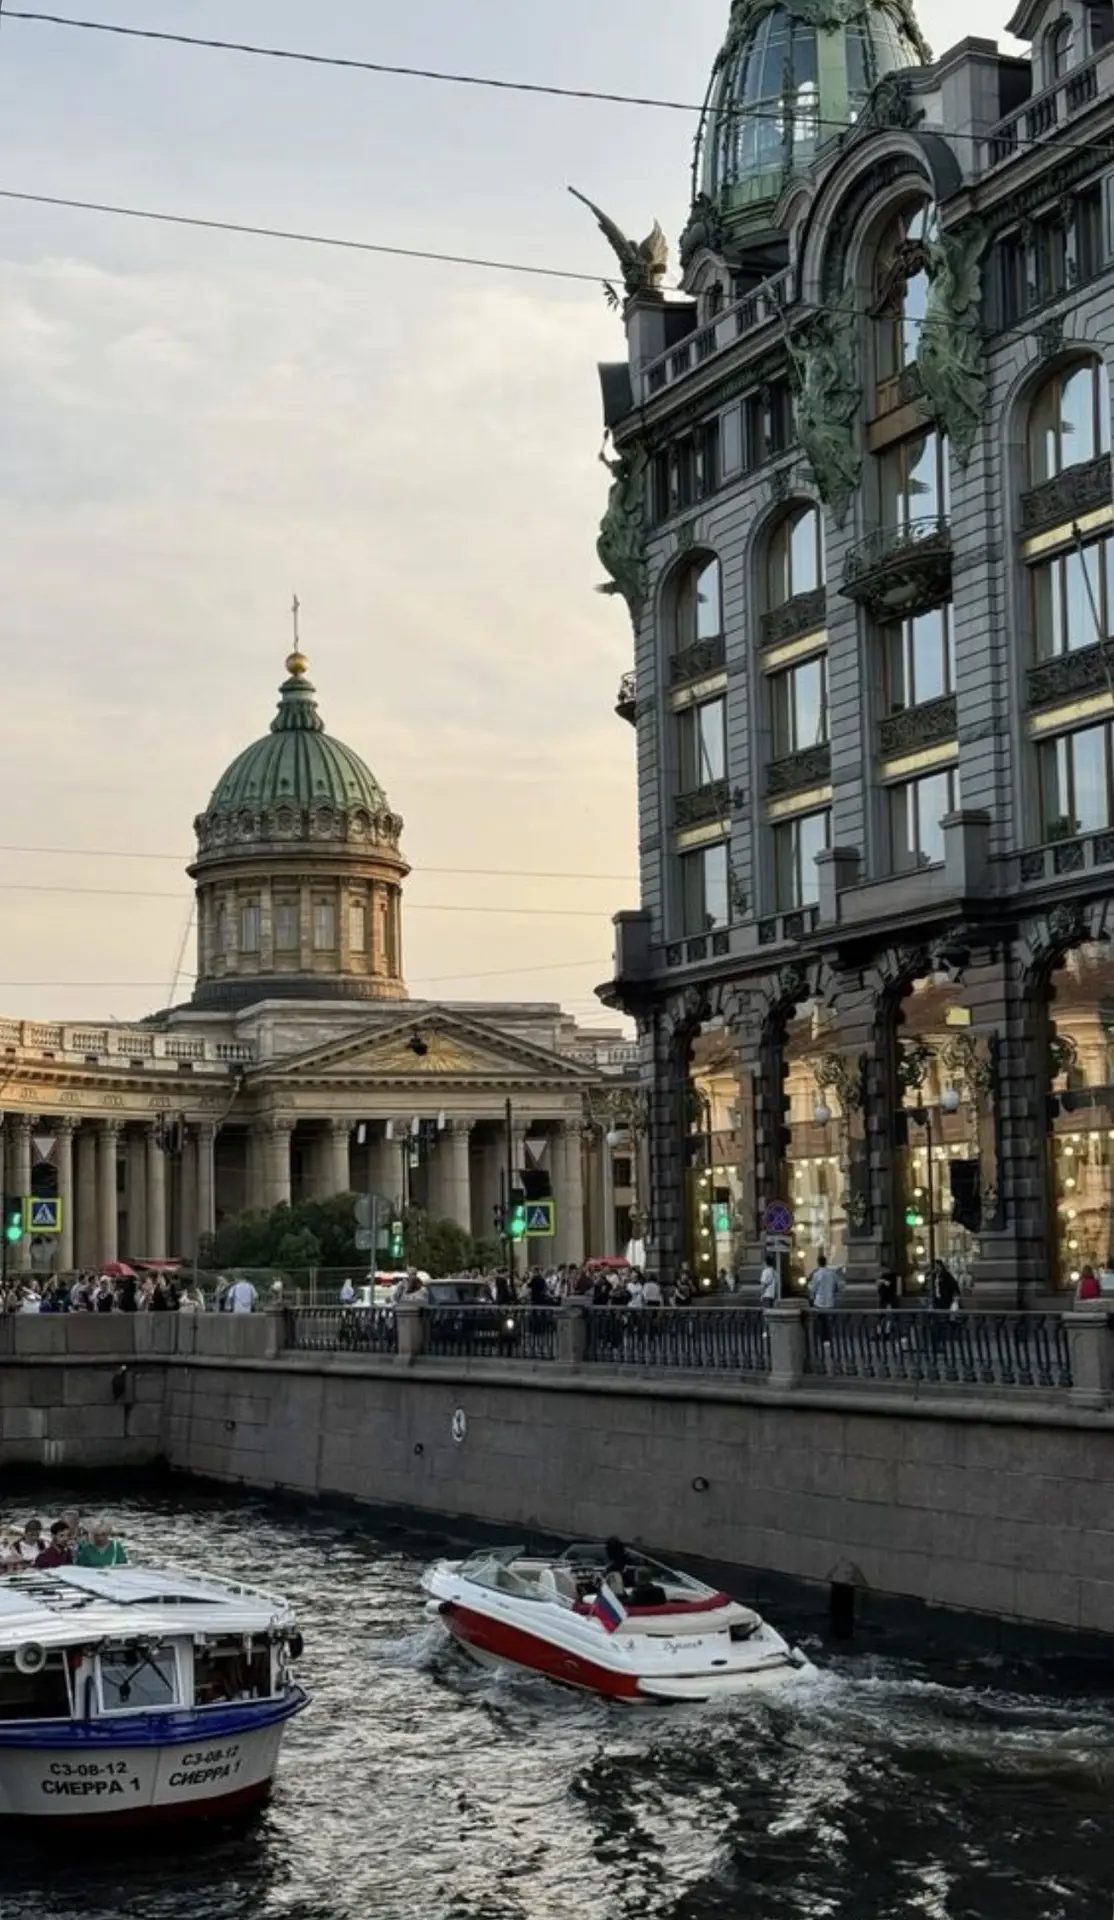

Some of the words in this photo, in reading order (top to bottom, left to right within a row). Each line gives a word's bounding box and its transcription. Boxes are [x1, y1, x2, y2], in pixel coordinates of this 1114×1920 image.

[169, 1764, 231, 1787] СИЕРРА
[233, 1759, 241, 1773] 1
[41, 1780, 124, 1795] СИЕРРА
[130, 1777, 141, 1791] 1
